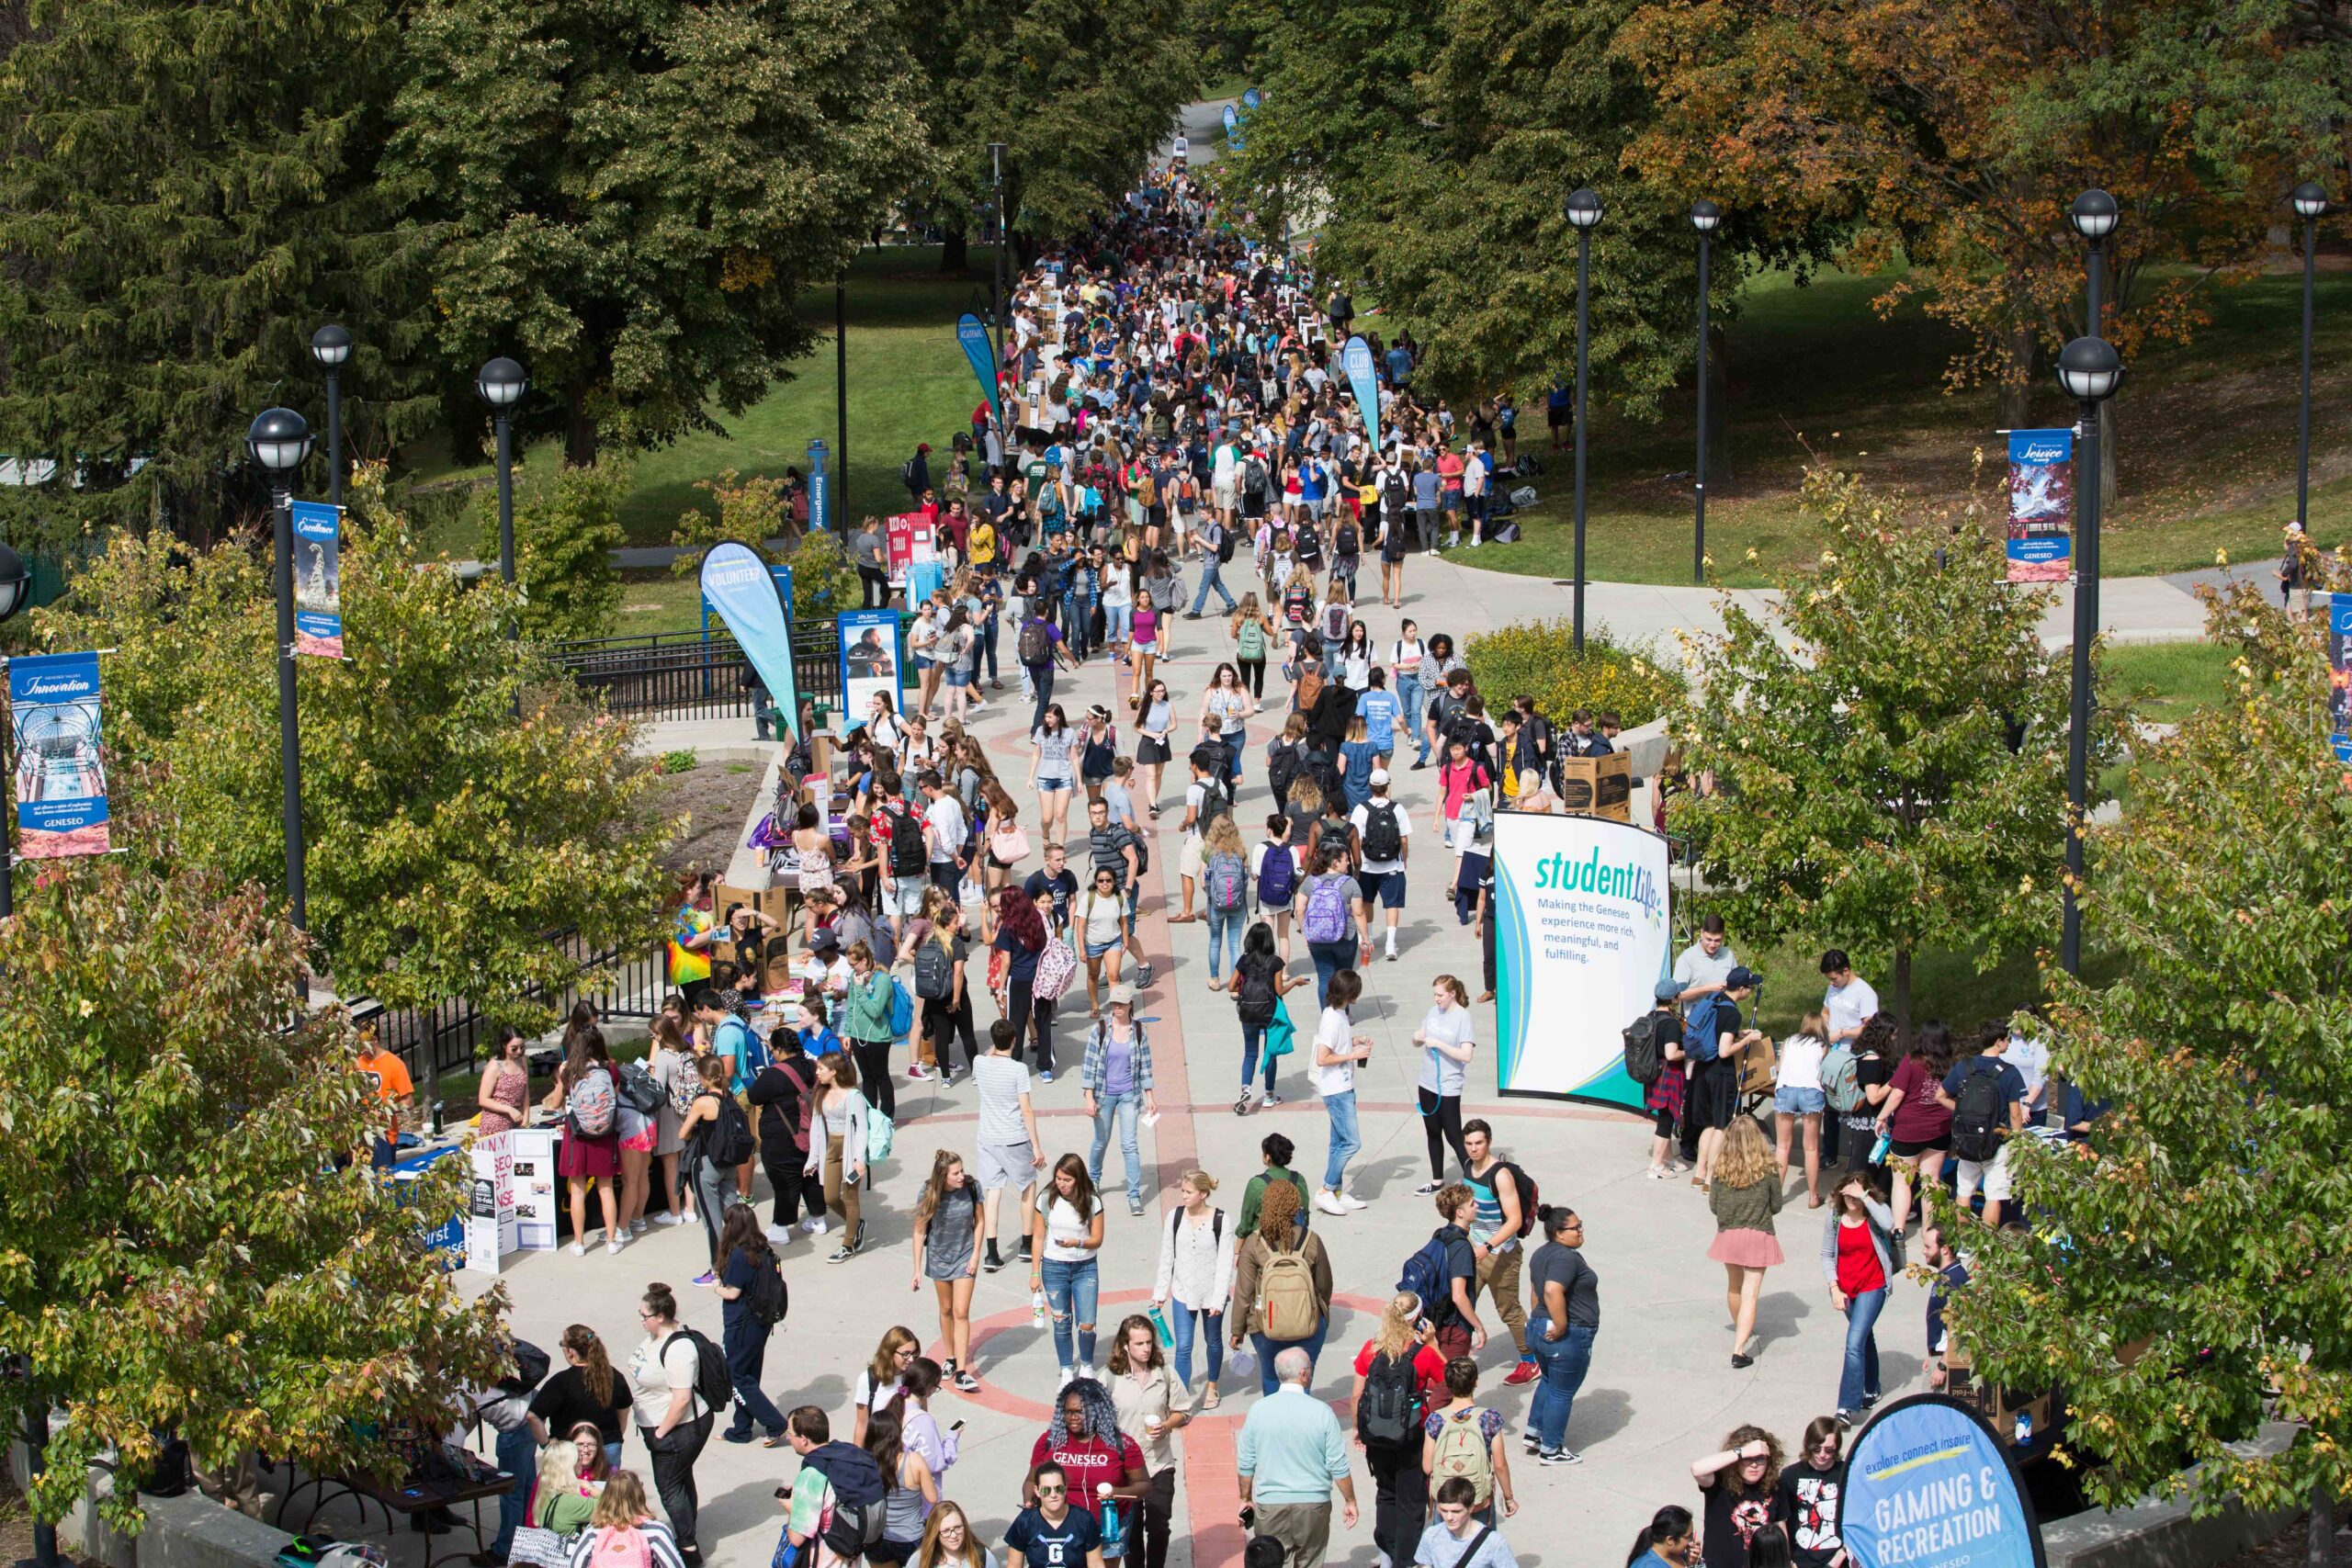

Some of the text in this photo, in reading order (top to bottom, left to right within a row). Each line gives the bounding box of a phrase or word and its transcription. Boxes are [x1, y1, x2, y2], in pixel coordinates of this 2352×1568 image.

[1350, 353, 1369, 368] CLUB
[1350, 368, 1371, 379] SPORTS
[2017, 442, 2063, 459] Service
[814, 477, 823, 527] Emergency
[298, 517, 334, 535] Excellence
[708, 567, 761, 587] VOLUNTEER
[20, 676, 90, 696] Innovation
[44, 817, 84, 828] GENESEO
[1538, 898, 1630, 919] Making the Geneseo
[1541, 917, 1636, 940] experience more rich,
[1544, 933, 1619, 951] meaningful, and
[1545, 948, 1589, 964] fulfilling.
[1053, 1451, 1108, 1465] GENESEO
[1865, 1433, 1972, 1474] explore connect inspire
[1875, 1466, 1996, 1533] GAMING &
[1877, 1503, 2001, 1567] RECREATION
[1048, 1543, 1063, 1563] G
